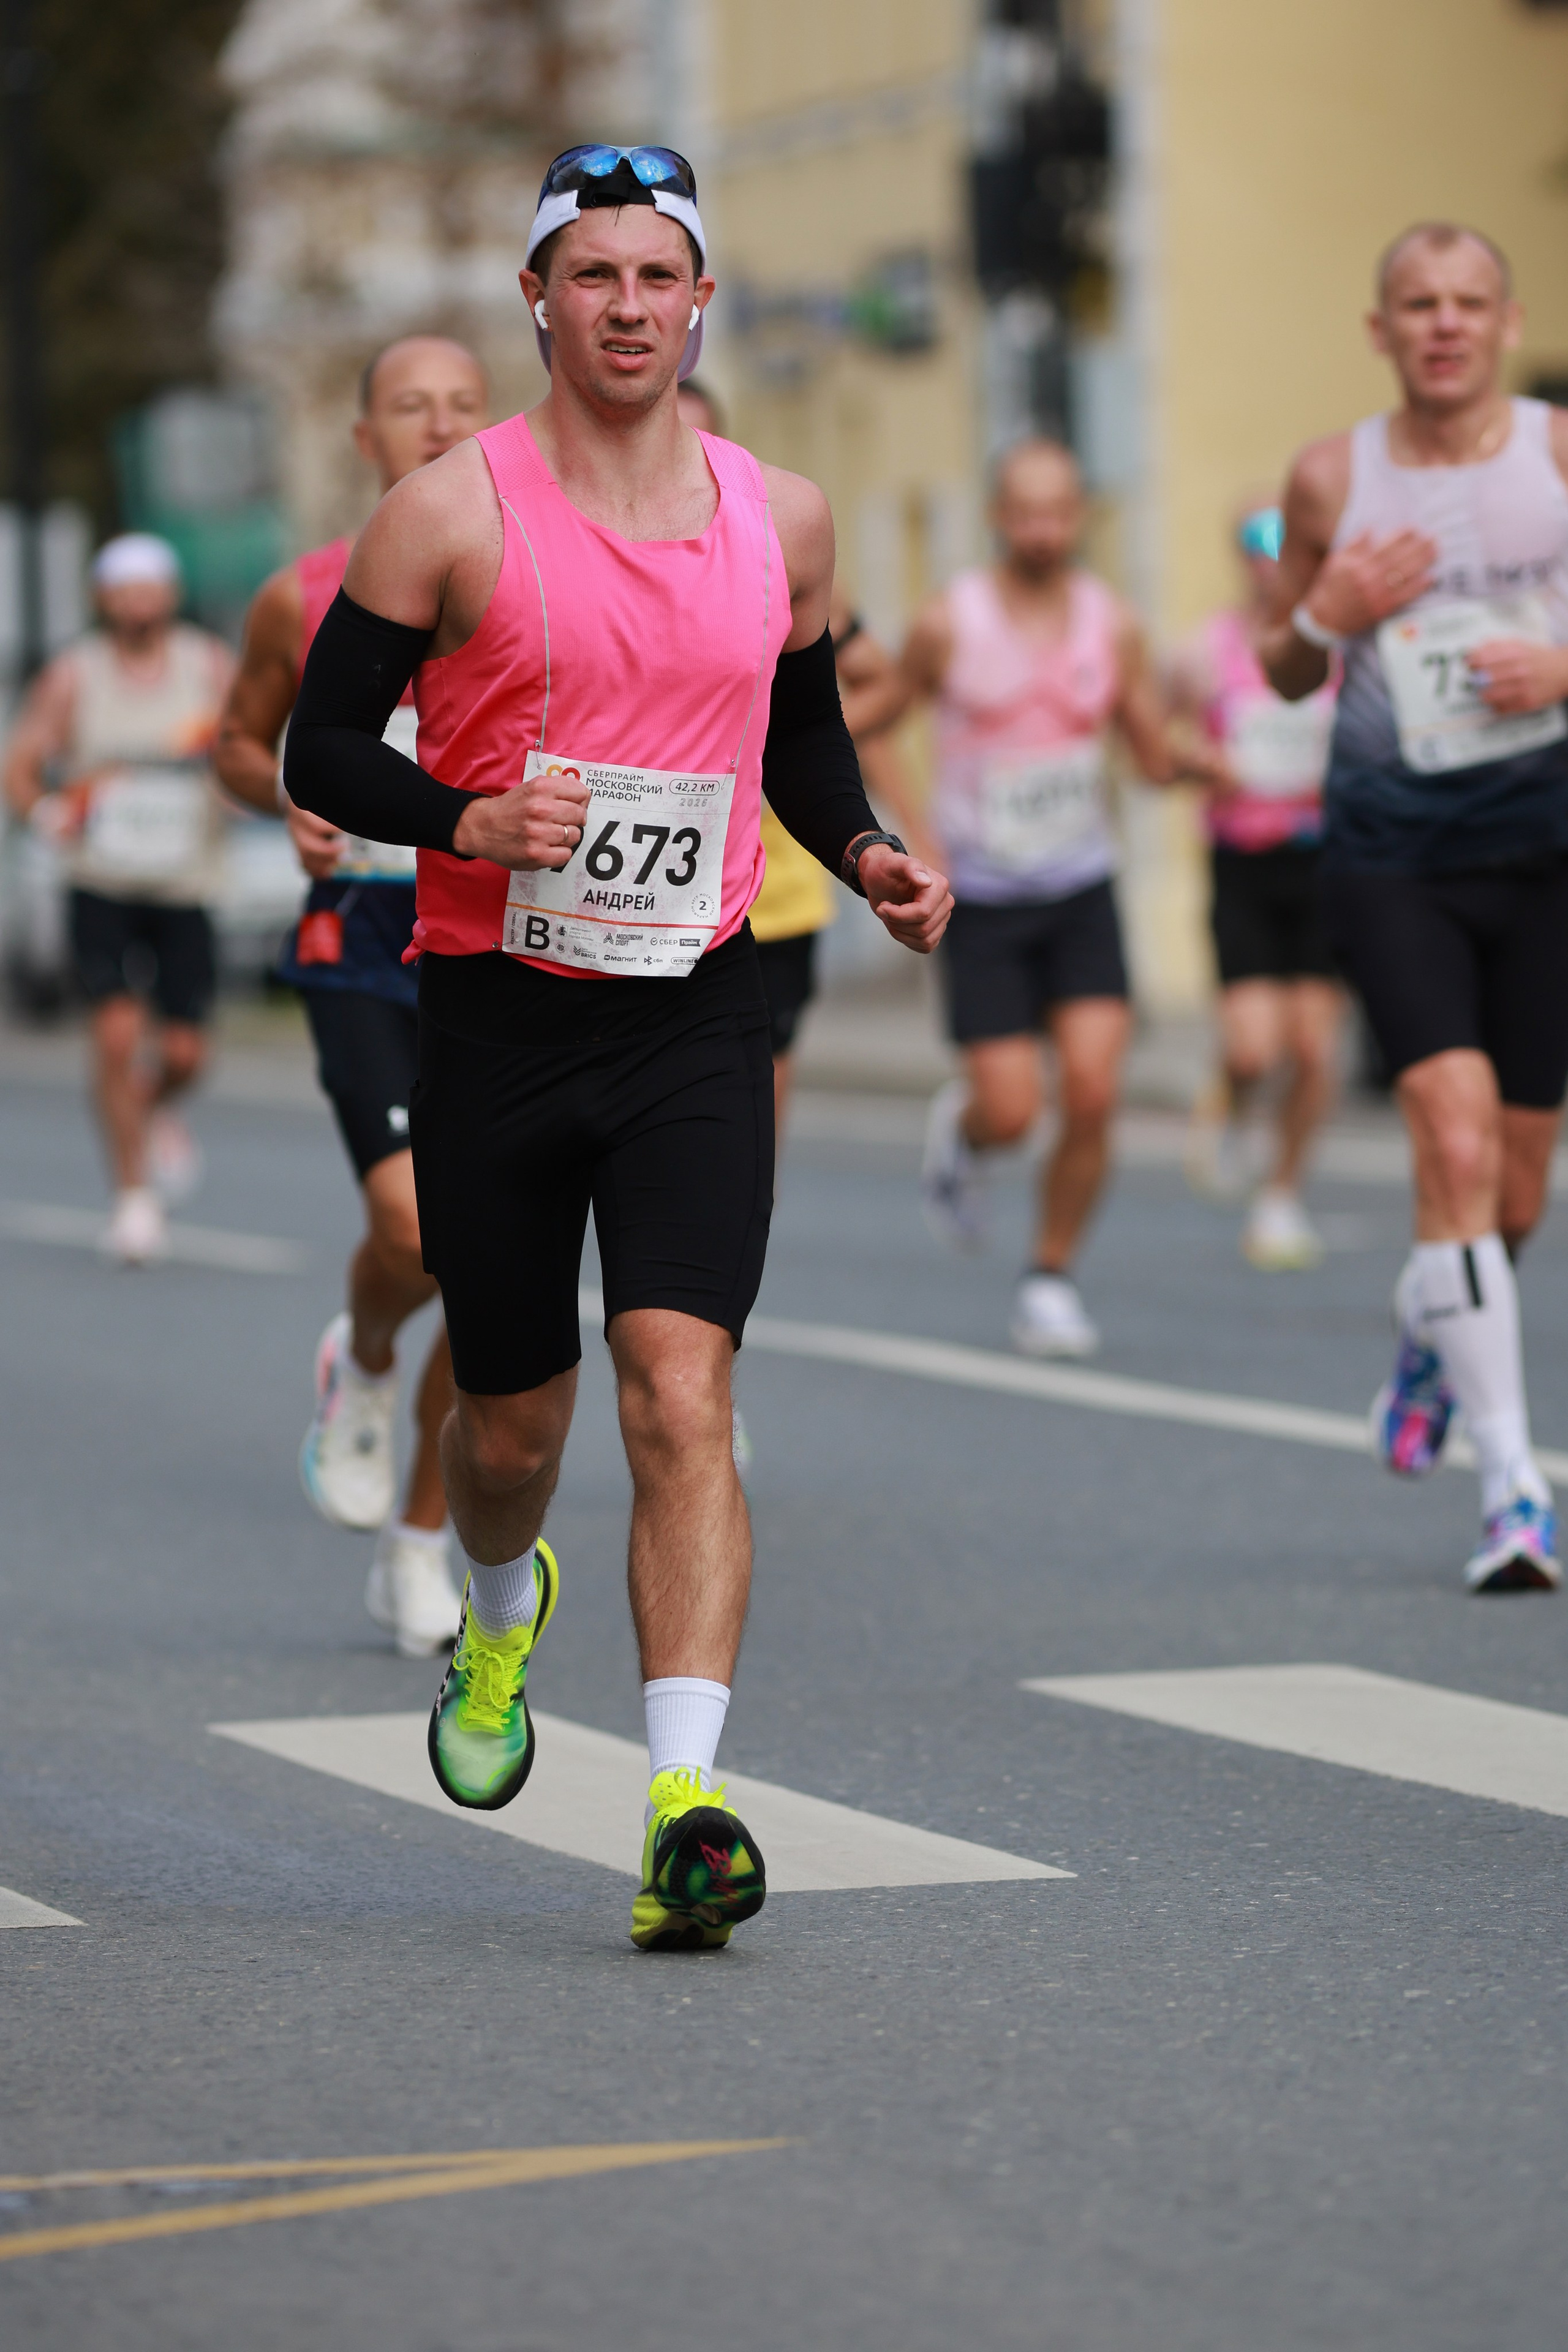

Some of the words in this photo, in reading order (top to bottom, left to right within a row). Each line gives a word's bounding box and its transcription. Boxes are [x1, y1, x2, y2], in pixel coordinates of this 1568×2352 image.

[587, 769, 644, 782] СБЕРПРАЙМ
[586, 778, 663, 794] МОСКОВСКИЙ
[675, 782, 697, 793] 42,2
[679, 797, 708, 807] 2026
[582, 889, 655, 911] АНДРЕЙ
[699, 900, 707, 910] 2
[525, 915, 550, 951] B
